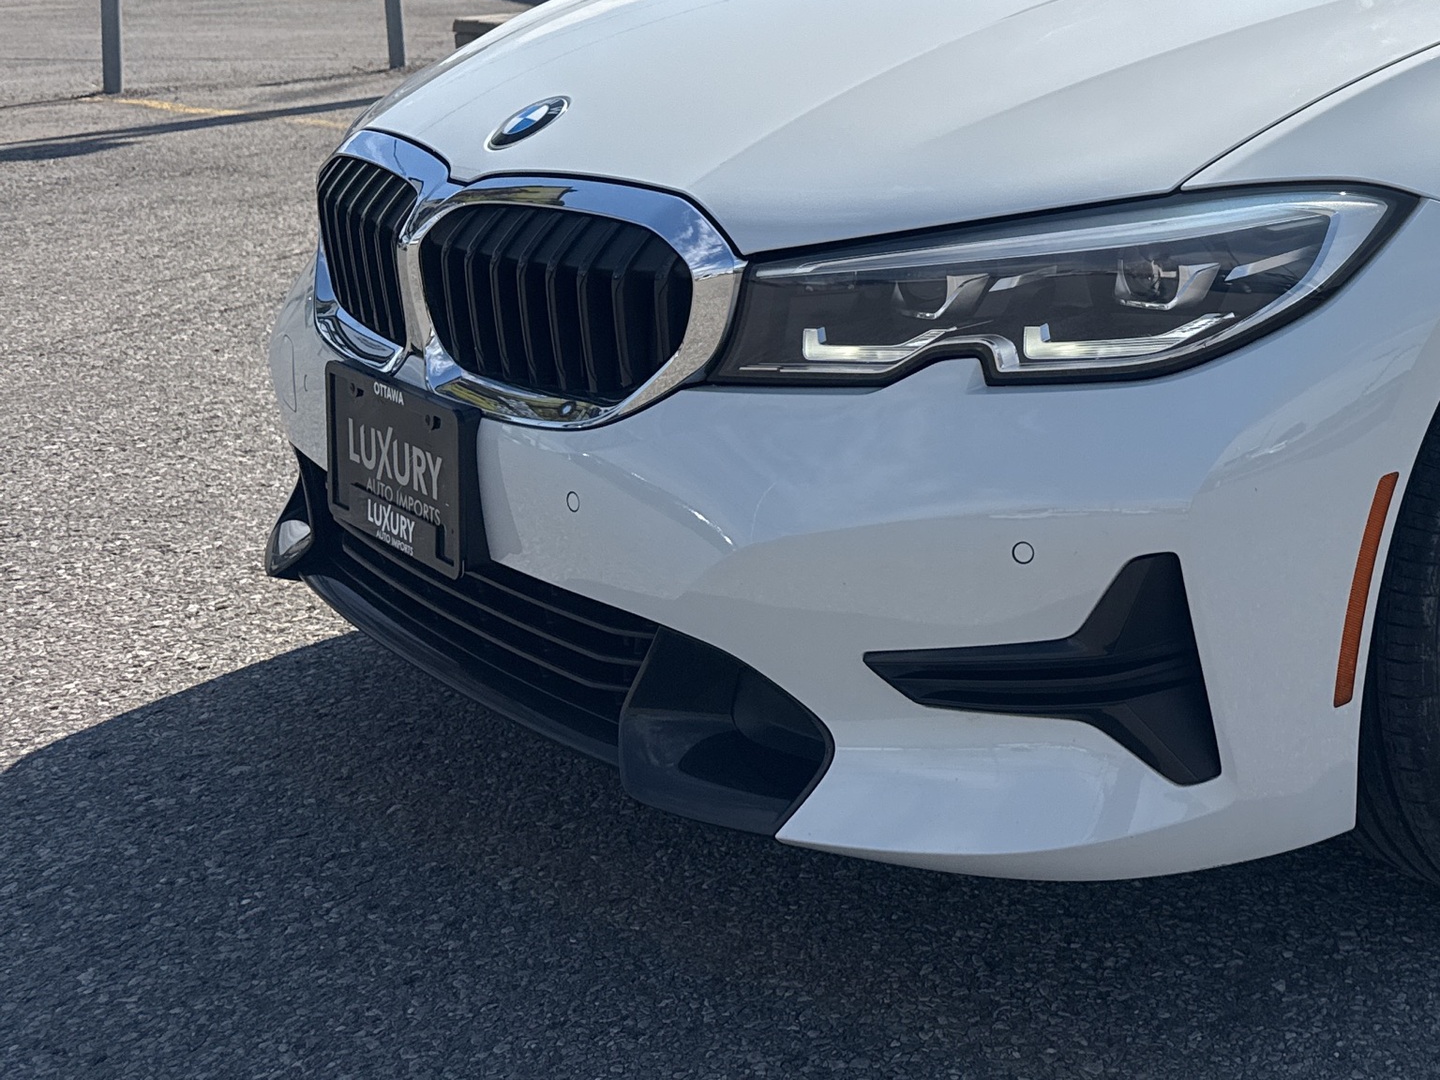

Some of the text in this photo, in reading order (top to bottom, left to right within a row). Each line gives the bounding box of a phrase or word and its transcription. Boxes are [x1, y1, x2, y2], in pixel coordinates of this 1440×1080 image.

[373, 381, 404, 406] OTTAWA
[348, 417, 442, 501] LUXURY
[366, 477, 441, 526] AUTO IMPORTS
[367, 499, 416, 544] LUXURY
[376, 530, 414, 557] AUTO IMPORTS
